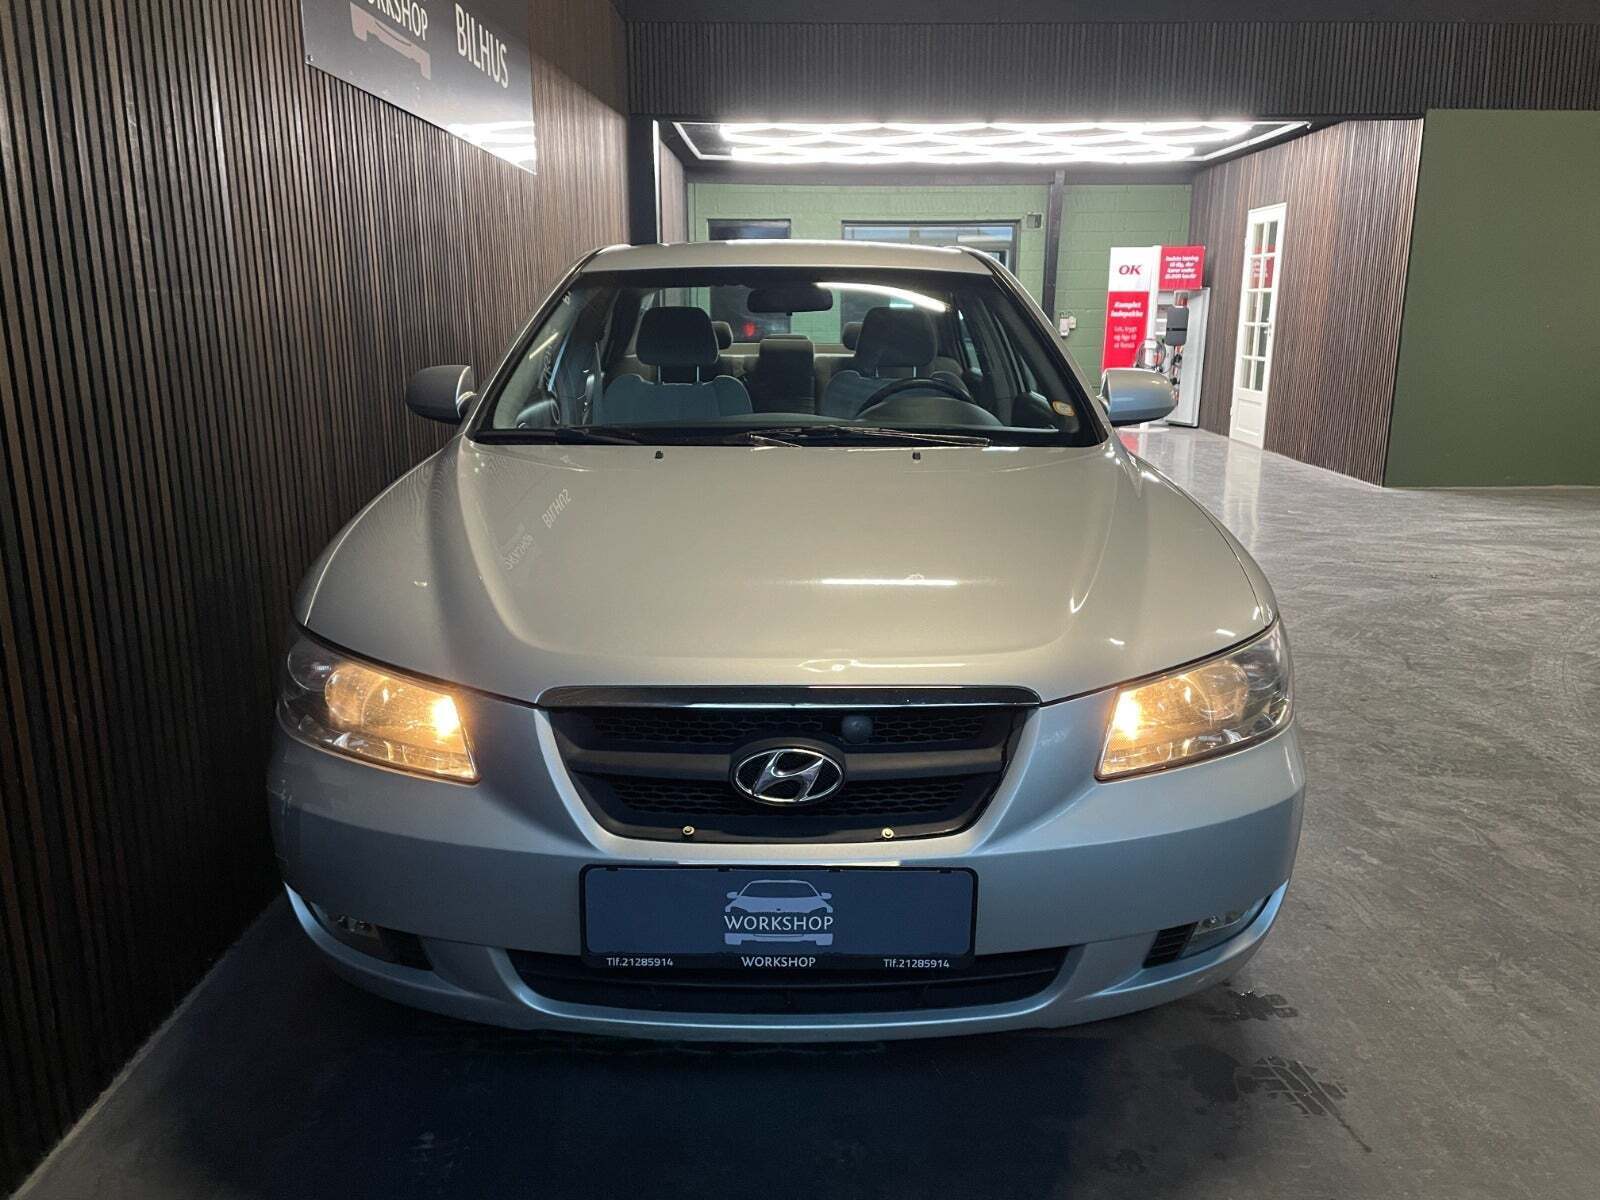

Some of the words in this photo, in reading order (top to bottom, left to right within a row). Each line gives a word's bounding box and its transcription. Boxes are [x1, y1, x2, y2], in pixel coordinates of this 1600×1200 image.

[368, 0, 428, 41] SHOP
[455, 3, 509, 88] BILHUS
[1118, 264, 1142, 275] OK
[724, 915, 834, 932] WORKSHOP
[741, 956, 816, 968] WORKSHOP
